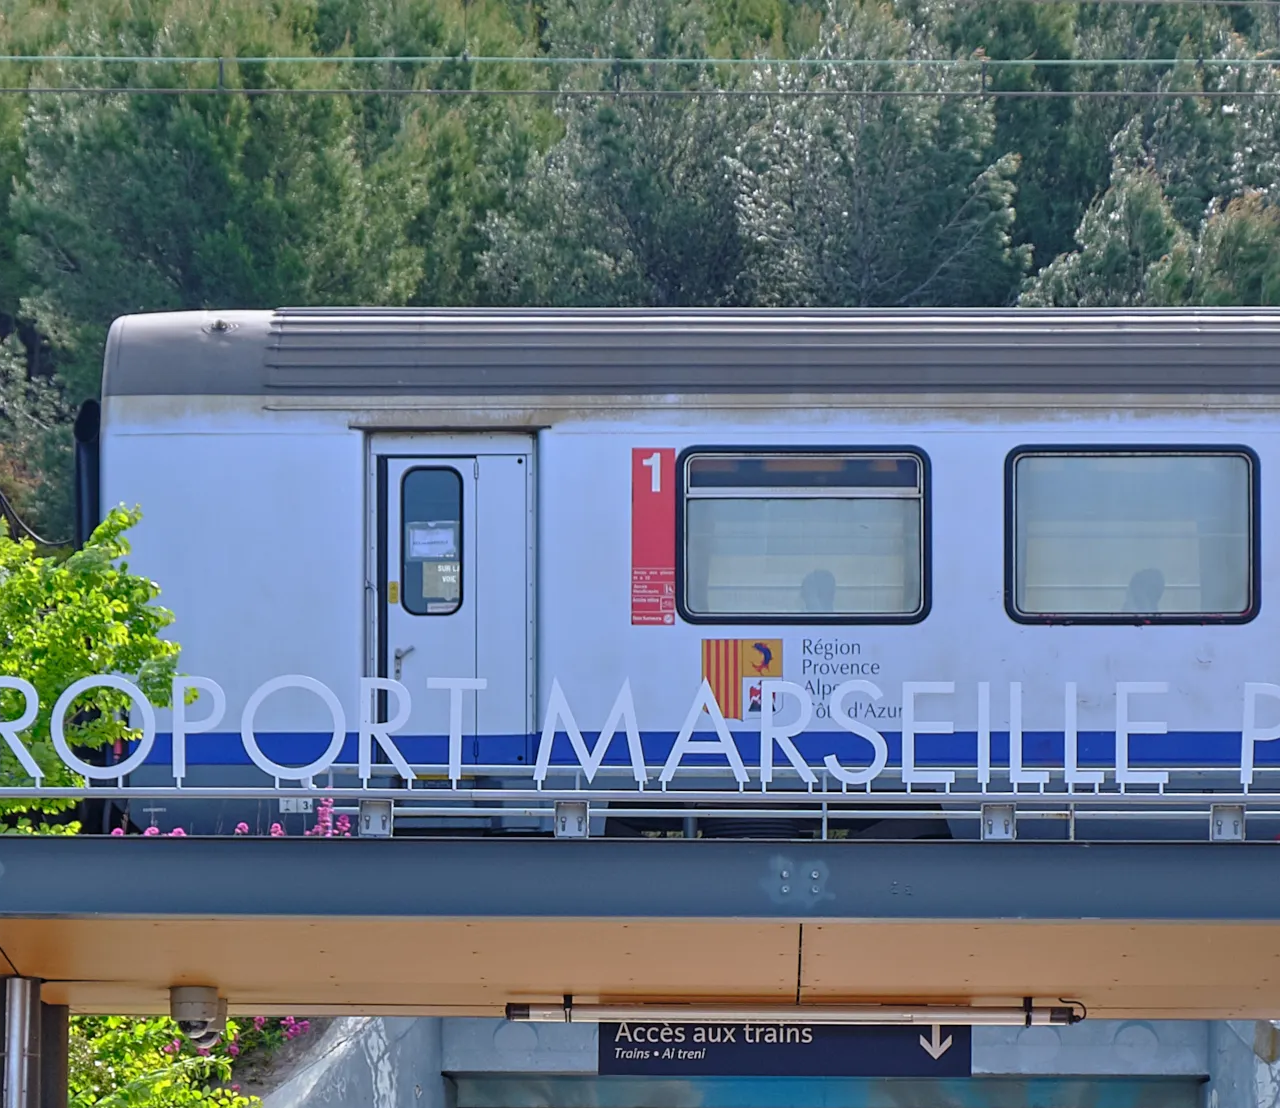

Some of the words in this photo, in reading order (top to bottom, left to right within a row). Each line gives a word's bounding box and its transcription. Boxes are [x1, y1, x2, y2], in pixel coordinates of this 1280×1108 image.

[642, 453, 661, 492] 1
[803, 638, 861, 660] Région
[803, 659, 880, 675] Provence
[805, 678, 840, 701] Alp
[535, 677, 1170, 784] MARSEILLE
[615, 1022, 686, 1043] Accès
[693, 1027, 736, 1043] aux
[743, 1024, 813, 1043] trains
[615, 1048, 650, 1059] Trains
[662, 1048, 675, 1059] Ai
[678, 1048, 706, 1059] treni
